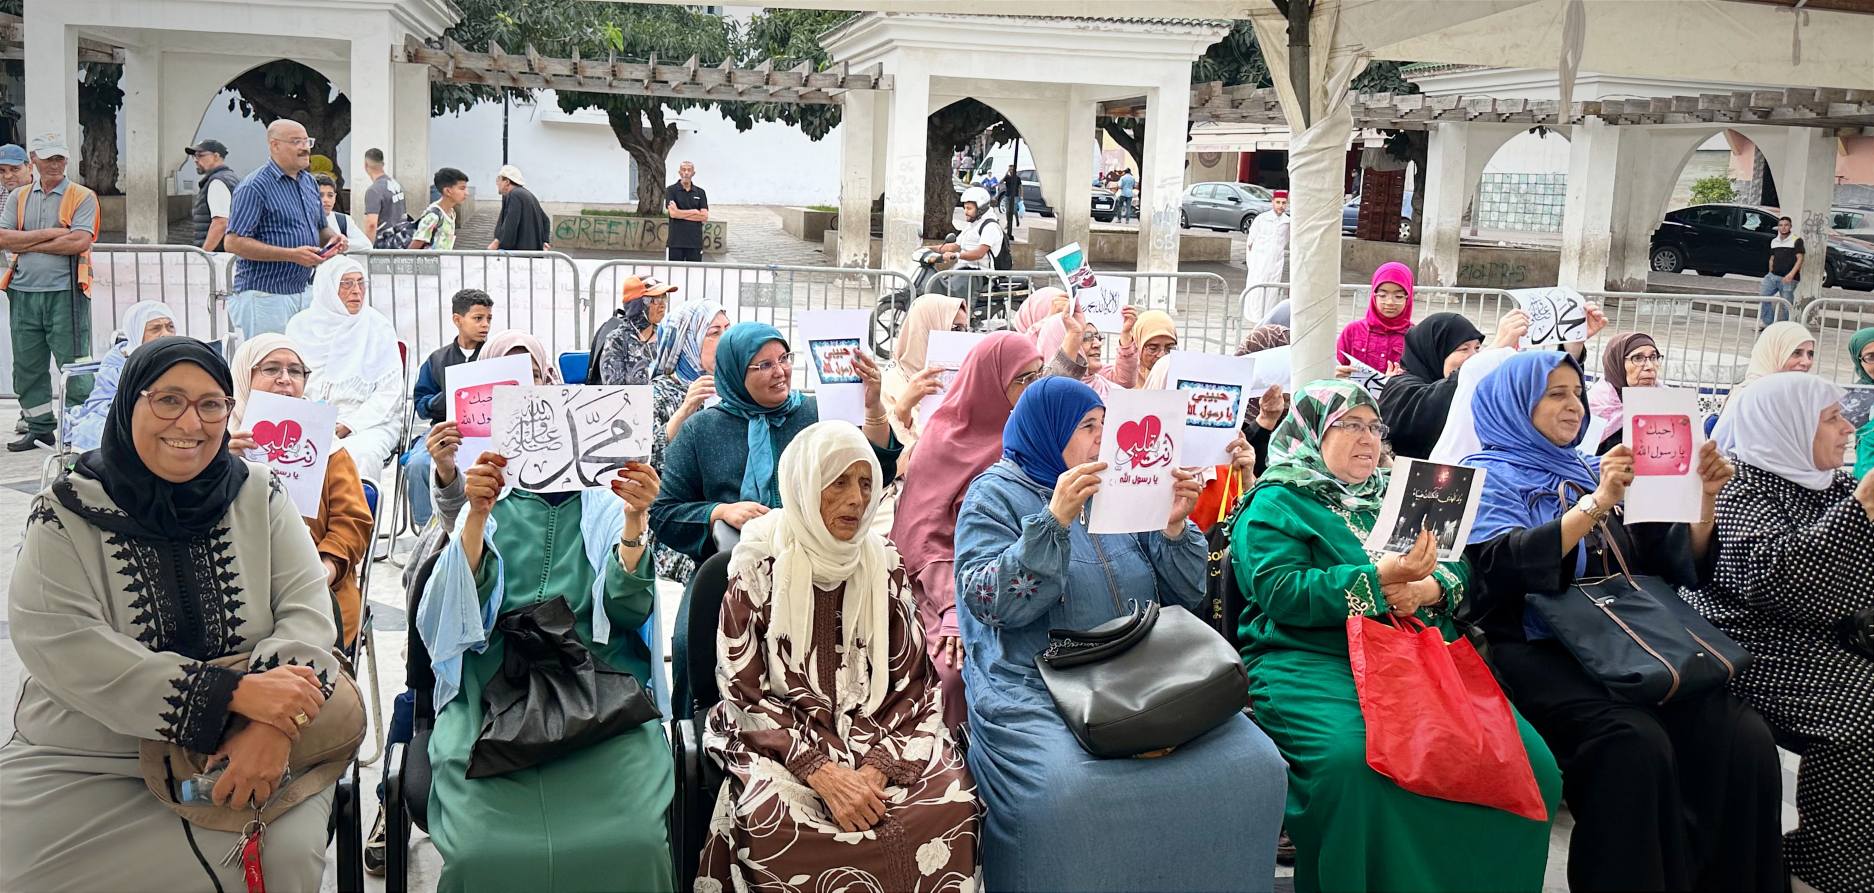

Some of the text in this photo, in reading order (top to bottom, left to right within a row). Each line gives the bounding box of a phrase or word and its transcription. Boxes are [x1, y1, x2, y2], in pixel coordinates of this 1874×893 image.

[469, 391, 493, 405] حبك
[1192, 392, 1229, 403] حبيبي
[1200, 405, 1224, 421] رسول
[1636, 440, 1686, 459] يا رسول الله
[1119, 472, 1159, 485] يا رسول الله
